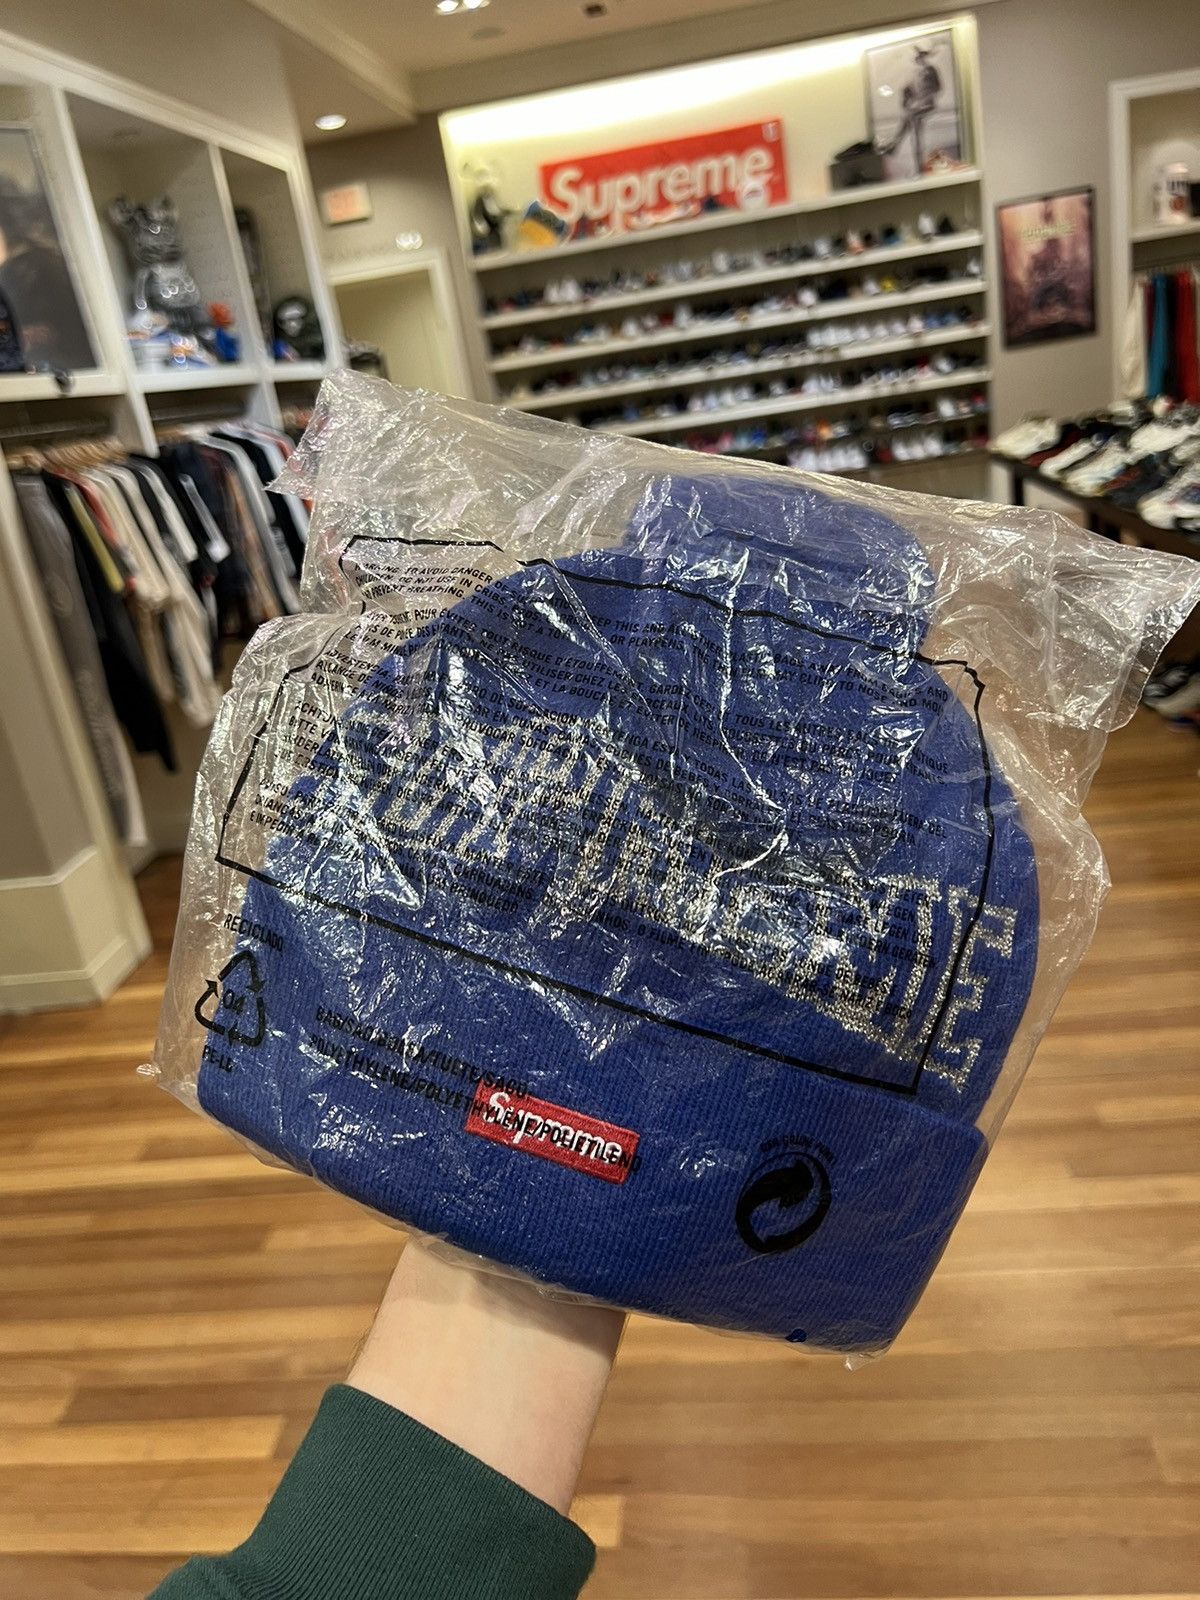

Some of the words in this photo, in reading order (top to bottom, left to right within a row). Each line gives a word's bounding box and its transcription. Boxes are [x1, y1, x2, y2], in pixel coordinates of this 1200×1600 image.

[551, 147, 773, 232] Supreme
[470, 594, 496, 614] THIS
[497, 609, 510, 621] IS
[450, 566, 493, 585] DANGER
[494, 580, 510, 594] OF
[615, 620, 639, 633] THIS
[846, 667, 878, 688] FROM
[926, 686, 949, 702] AND
[458, 576, 473, 589] IN
[610, 634, 625, 646] OR
[839, 680, 854, 692] TO
[857, 685, 888, 703] NOSE
[414, 607, 437, 621] POUR
[480, 628, 510, 644] TOUT
[511, 641, 554, 664] RISQUE
[649, 684, 691, 699] GARDEZ
[735, 713, 764, 729] TOUS
[769, 720, 792, 734] LES
[479, 638, 494, 650] NE
[521, 657, 574, 681] UTILISER
[575, 672, 606, 688] CHEZ
[534, 677, 550, 690] ET
[551, 684, 567, 695] LA
[356, 672, 373, 685] DE
[492, 711, 509, 725] EN
[321, 727, 342, 746] VO
[693, 758, 729, 783] TODAS
[223, 913, 284, 951] RECICLADO
